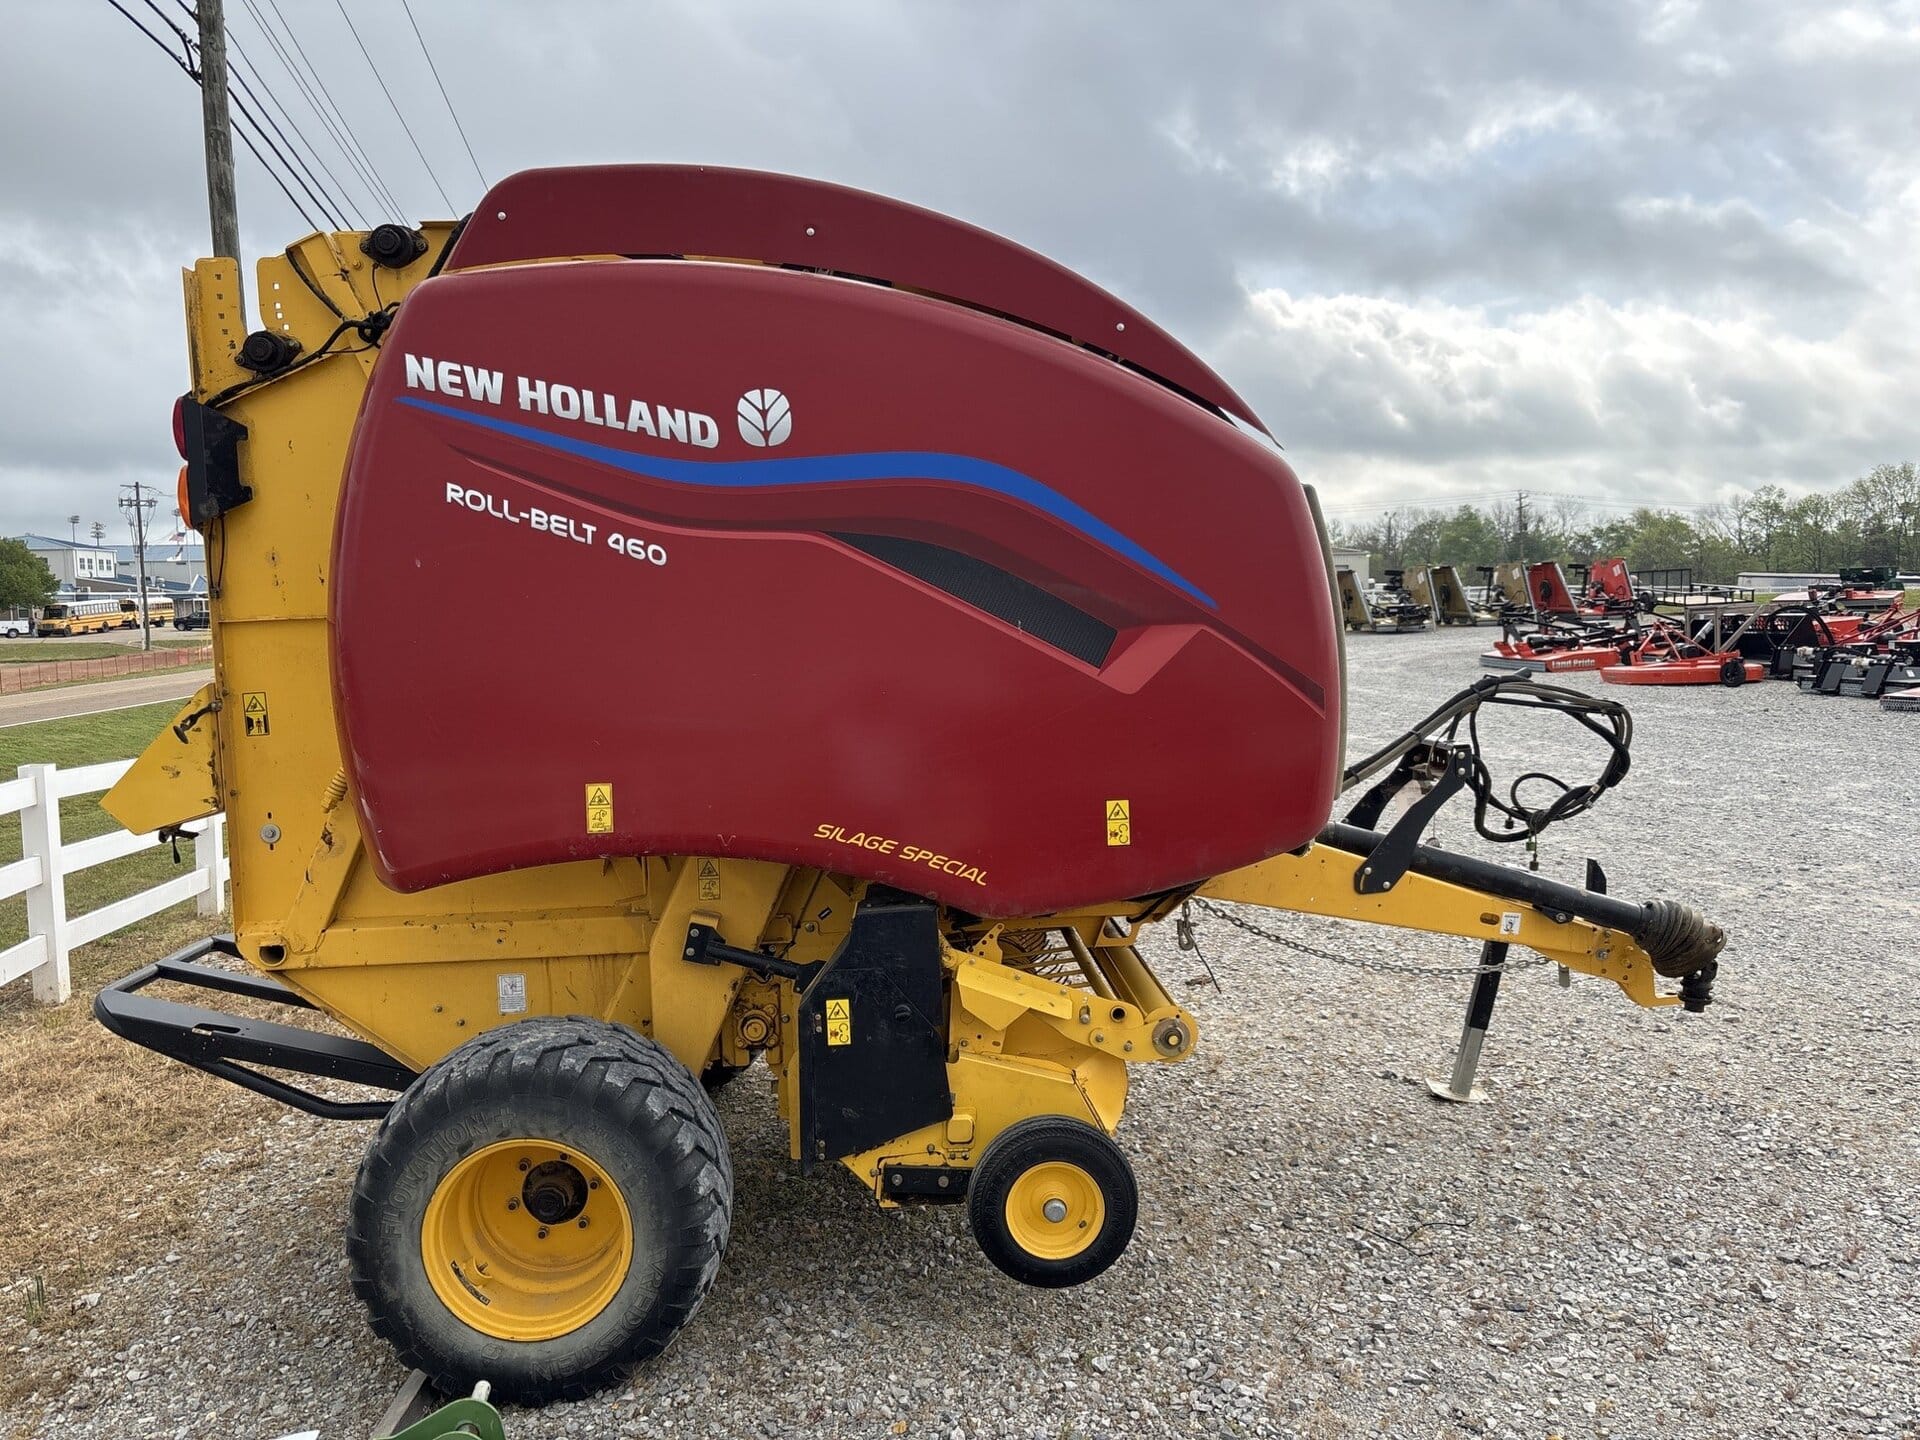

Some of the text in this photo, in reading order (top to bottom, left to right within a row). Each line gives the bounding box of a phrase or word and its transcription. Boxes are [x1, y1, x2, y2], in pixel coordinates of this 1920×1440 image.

[405, 353, 719, 448] NEW HOLLAND
[446, 482, 668, 566] ROLL-BELT 460
[1552, 658, 1595, 669] Land Pride
[814, 824, 988, 886] SILAGE SPECIAL
[382, 1111, 490, 1239] FLOTATION
